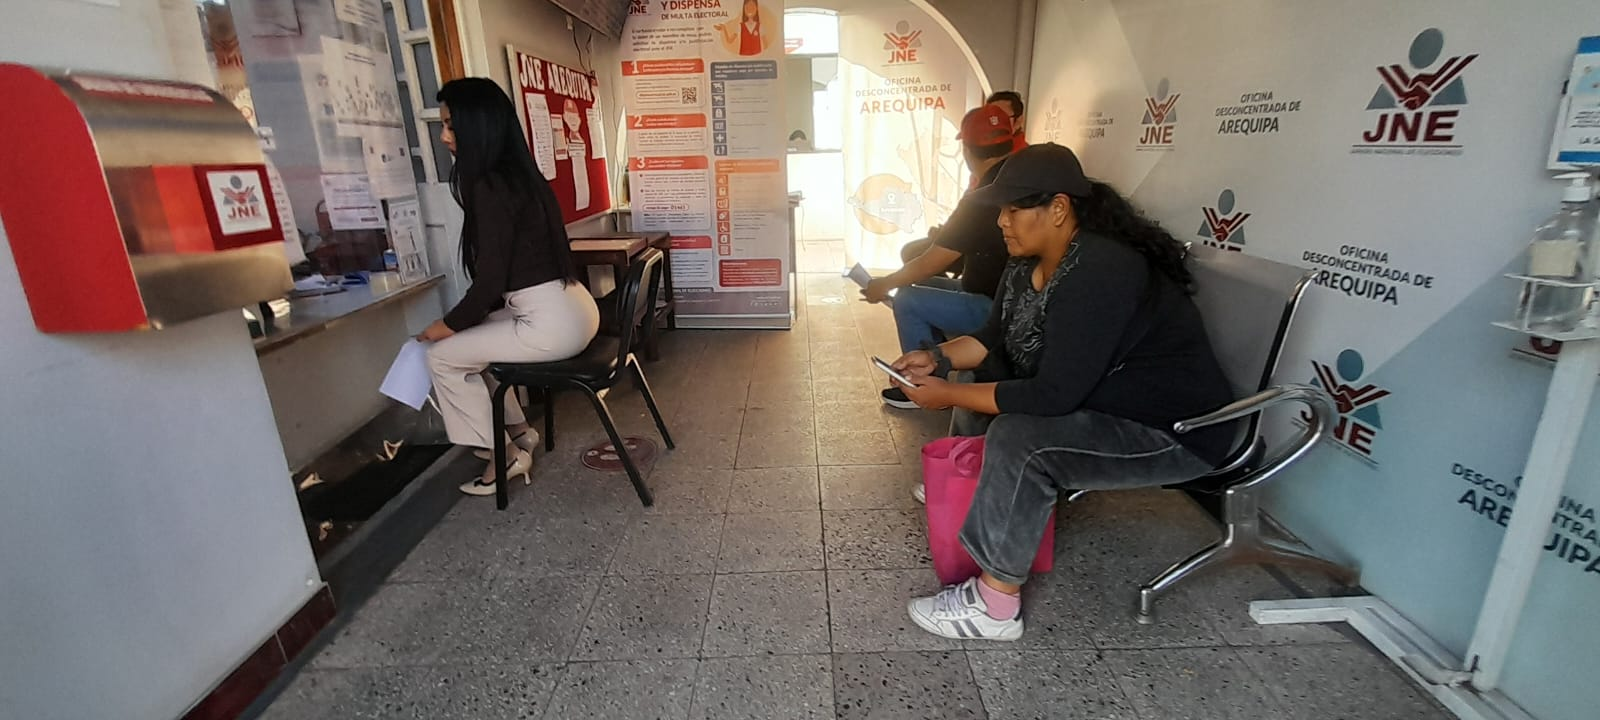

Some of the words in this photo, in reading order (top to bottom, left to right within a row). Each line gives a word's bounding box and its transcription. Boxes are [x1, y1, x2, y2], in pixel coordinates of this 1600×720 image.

[629, 5, 647, 15] JNE
[661, 1, 668, 10] Y
[670, 0, 721, 10] DISPENSA
[694, 11, 729, 19] ELECTORAL
[888, 49, 917, 63] JNE
[631, 60, 639, 74] 1
[519, 53, 545, 91] JNE
[547, 62, 592, 102] AREQUIPA
[884, 76, 921, 87] OFICINA
[855, 85, 938, 97] DESCONCENTRADA
[940, 83, 952, 92] DE
[1240, 91, 1273, 103] OFICINA
[860, 96, 946, 114] AREQUIPA
[1215, 102, 1287, 116] DESCONCENTRADA
[1288, 100, 1302, 112] DE
[634, 115, 643, 127] 2
[1218, 117, 1279, 135] AREQUIPA
[1363, 109, 1460, 143] JNE
[1140, 125, 1174, 144] JNE
[636, 156, 645, 169] 3
[228, 205, 262, 219] JNE
[1340, 244, 1389, 264] OFICINA
[1302, 250, 1410, 283] DESCONCENTRADA
[1413, 274, 1434, 288] DE
